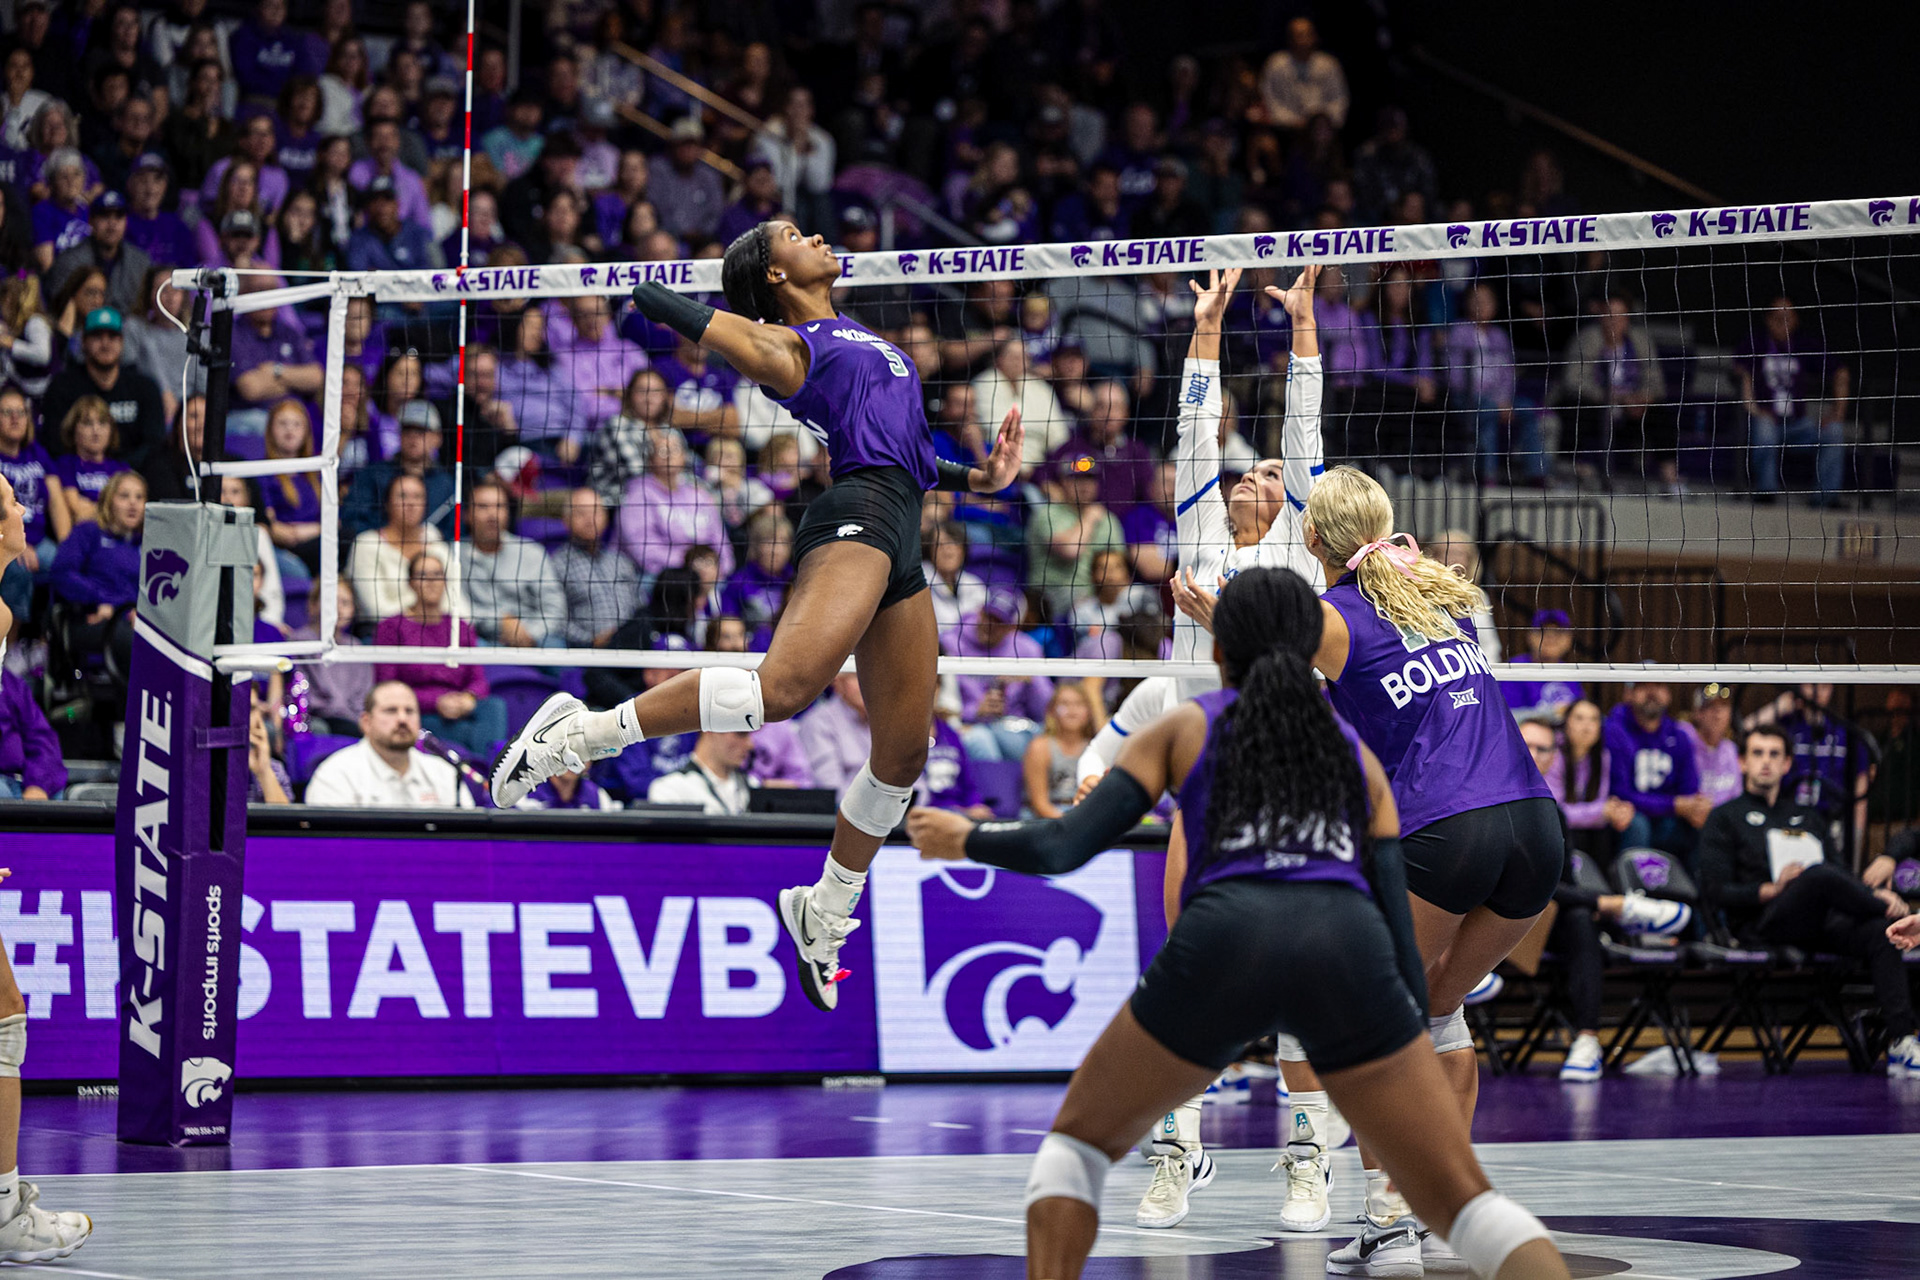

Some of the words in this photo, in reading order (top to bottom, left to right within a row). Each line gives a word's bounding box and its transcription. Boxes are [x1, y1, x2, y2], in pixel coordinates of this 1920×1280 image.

[456, 268, 541, 292] K-STATE
[606, 262, 694, 287] K-STATE
[928, 248, 1025, 275] K-STATE
[1102, 238, 1205, 267] K-STATE
[1286, 228, 1396, 258] K-STATE
[1481, 216, 1598, 249] K-STATE
[1688, 204, 1811, 238] K-STATE
[869, 341, 910, 377] 5
[1380, 642, 1497, 710] BOLDIN
[129, 688, 172, 1060] K-STATE
[205, 884, 222, 954] sports
[202, 956, 219, 1040] imports
